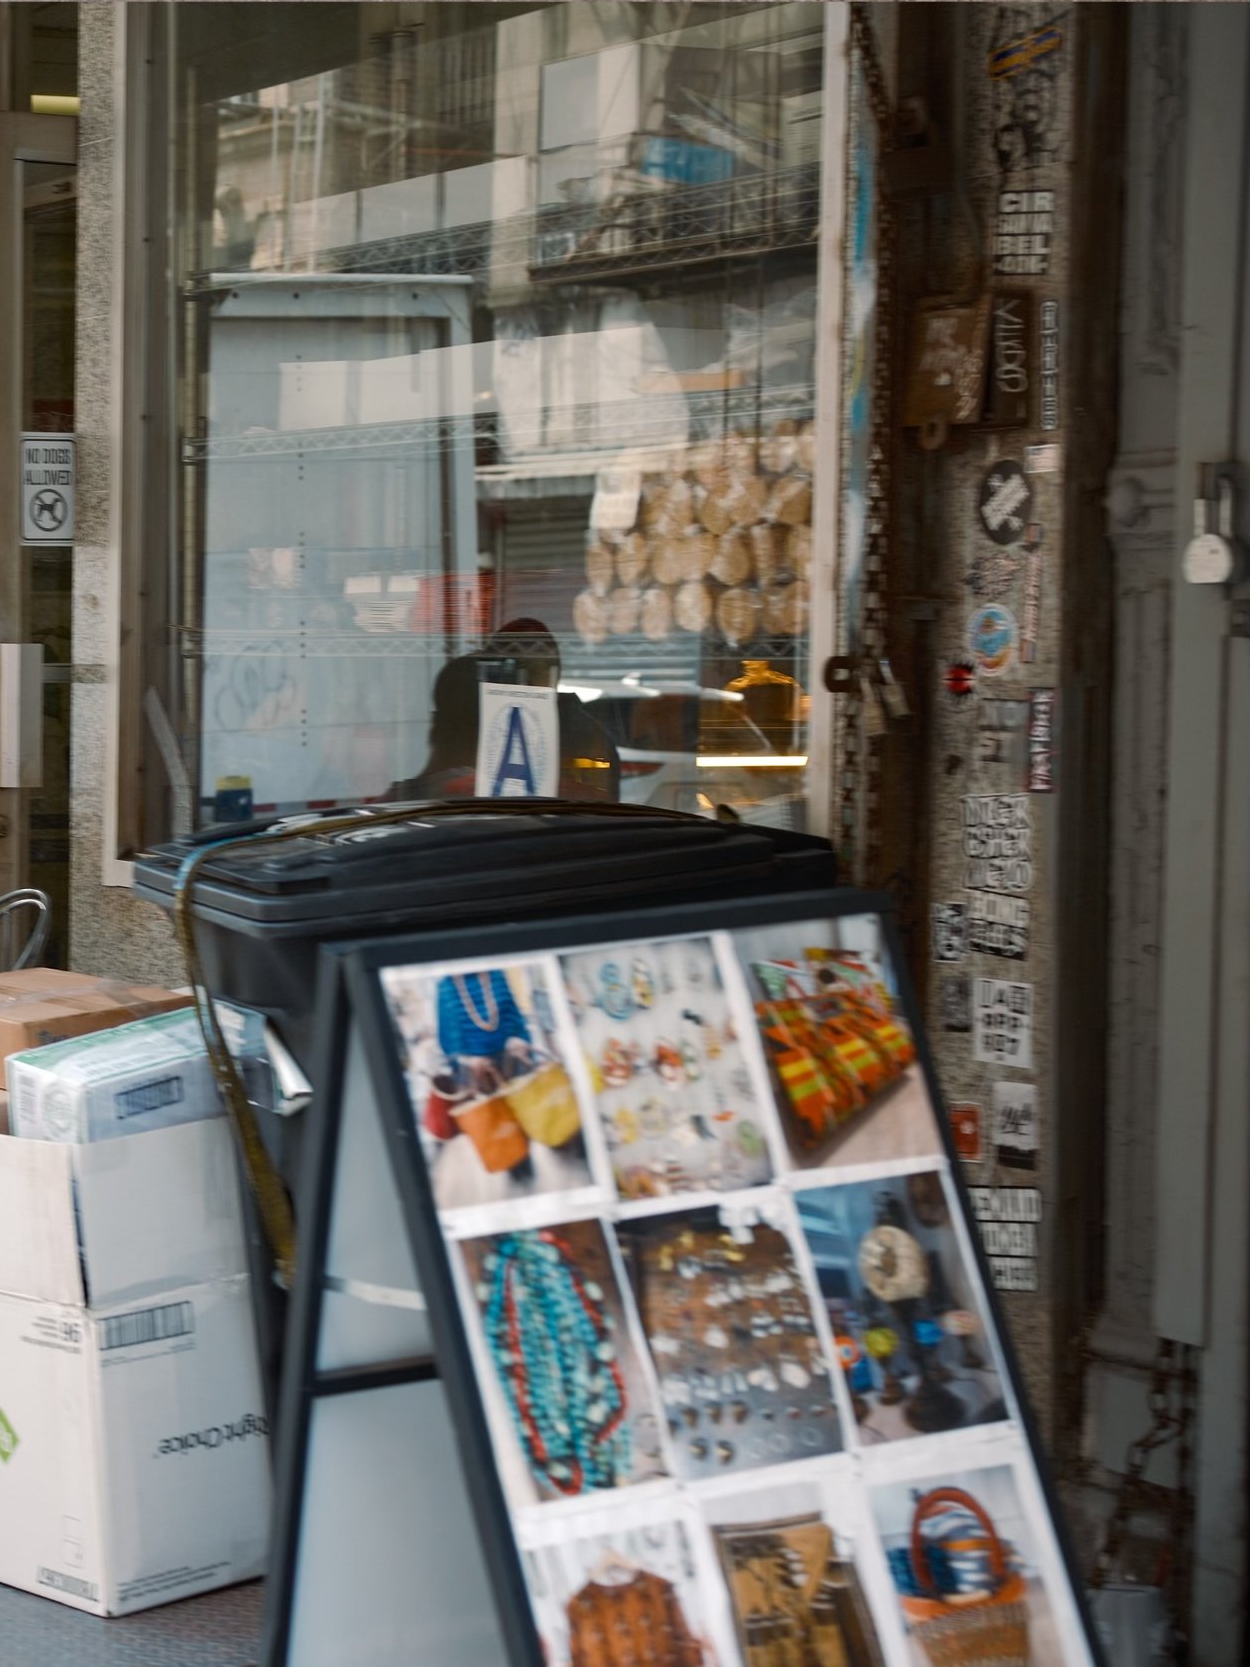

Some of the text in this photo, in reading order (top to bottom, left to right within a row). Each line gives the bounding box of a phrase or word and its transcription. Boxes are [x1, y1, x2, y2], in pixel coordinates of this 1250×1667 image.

[25, 447, 70, 464] NO DOGS
[23, 470, 71, 485] ALLOWED
[491, 706, 536, 797] A
